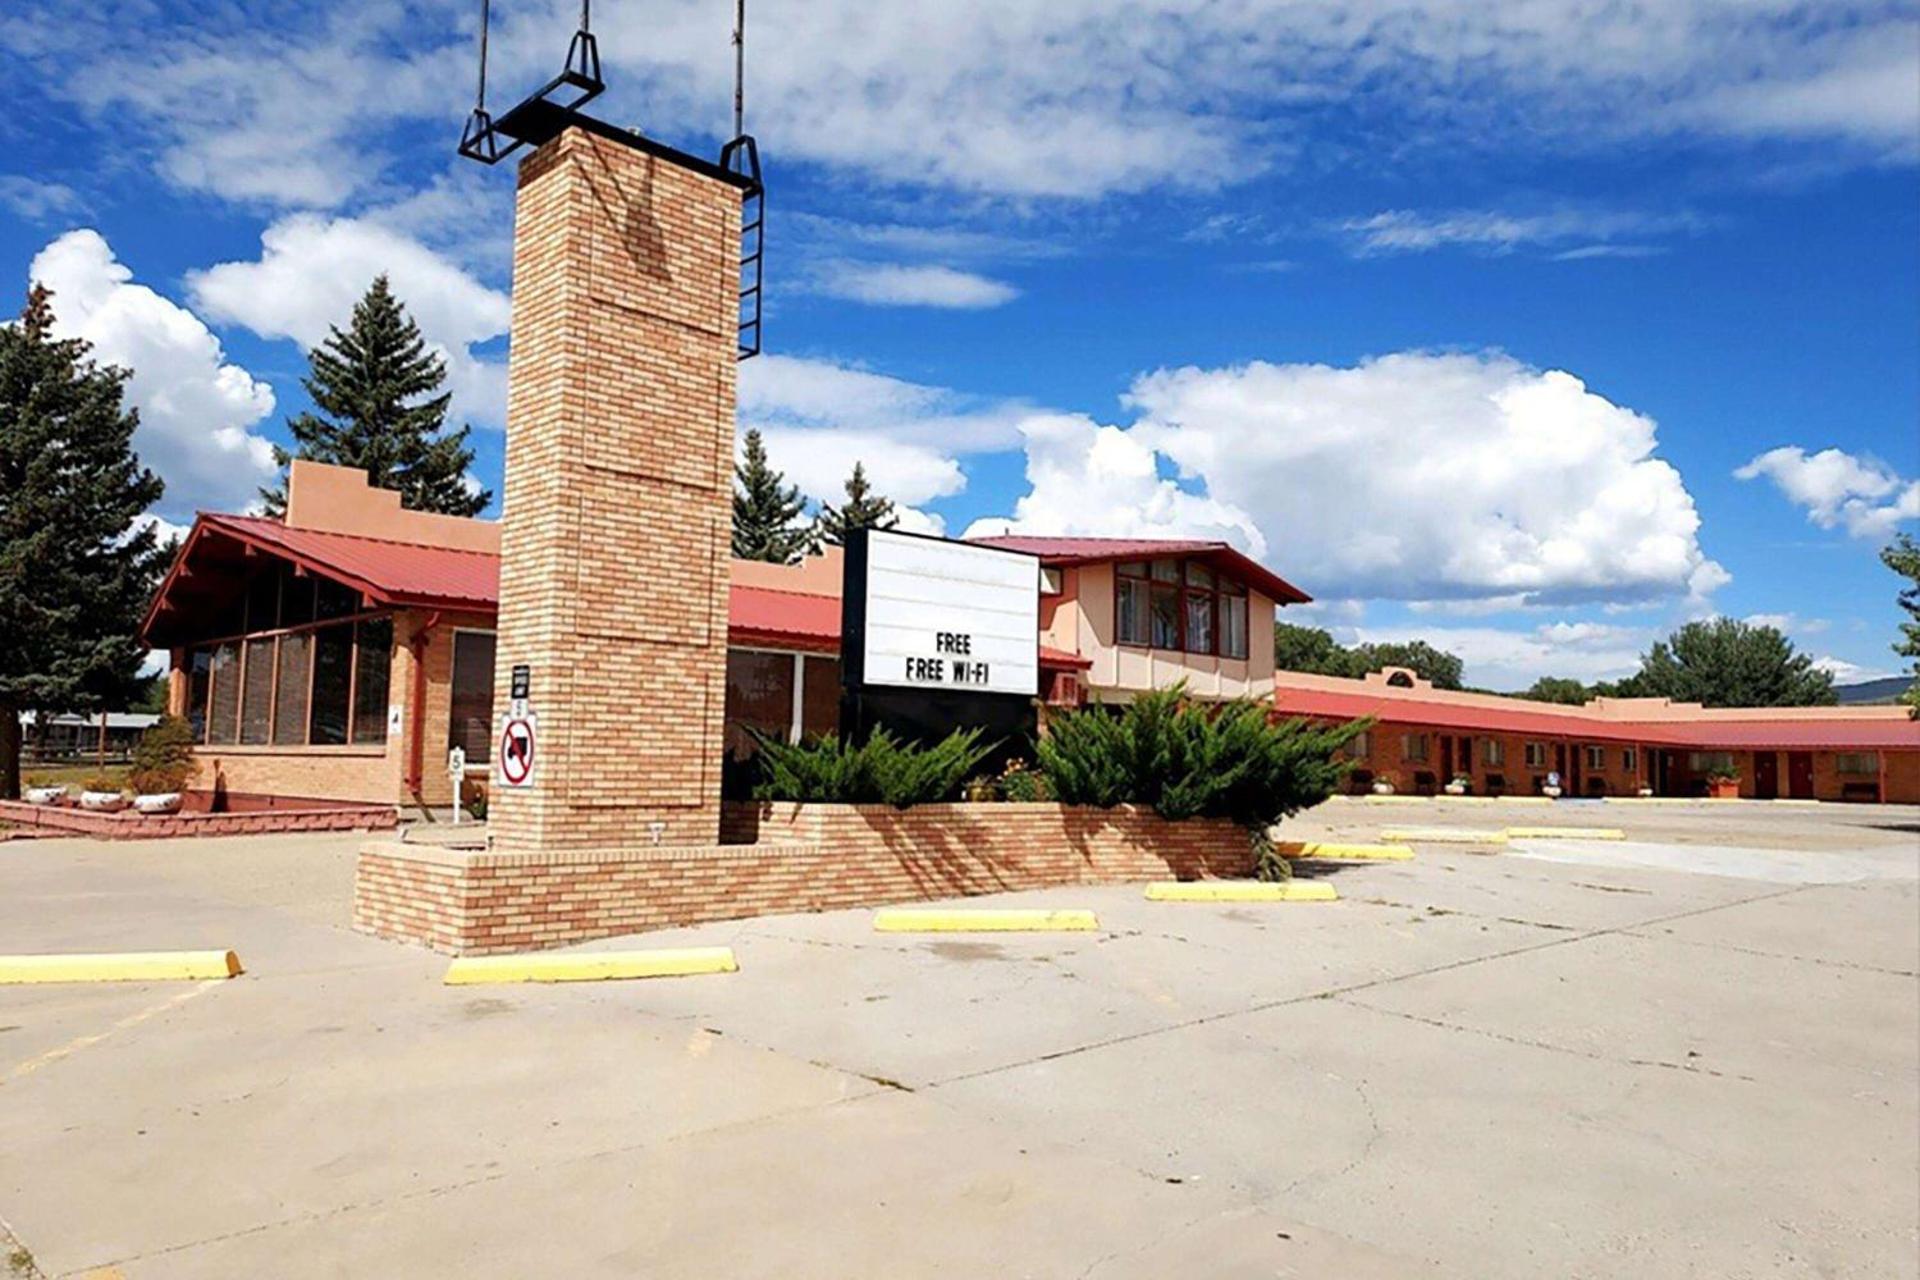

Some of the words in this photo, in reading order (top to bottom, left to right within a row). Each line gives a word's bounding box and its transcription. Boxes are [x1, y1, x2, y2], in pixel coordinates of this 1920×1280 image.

[936, 632, 971, 655] FREE
[906, 657, 944, 681] FREE
[952, 661, 989, 683] WI-FI
[452, 754, 461, 770] 5
